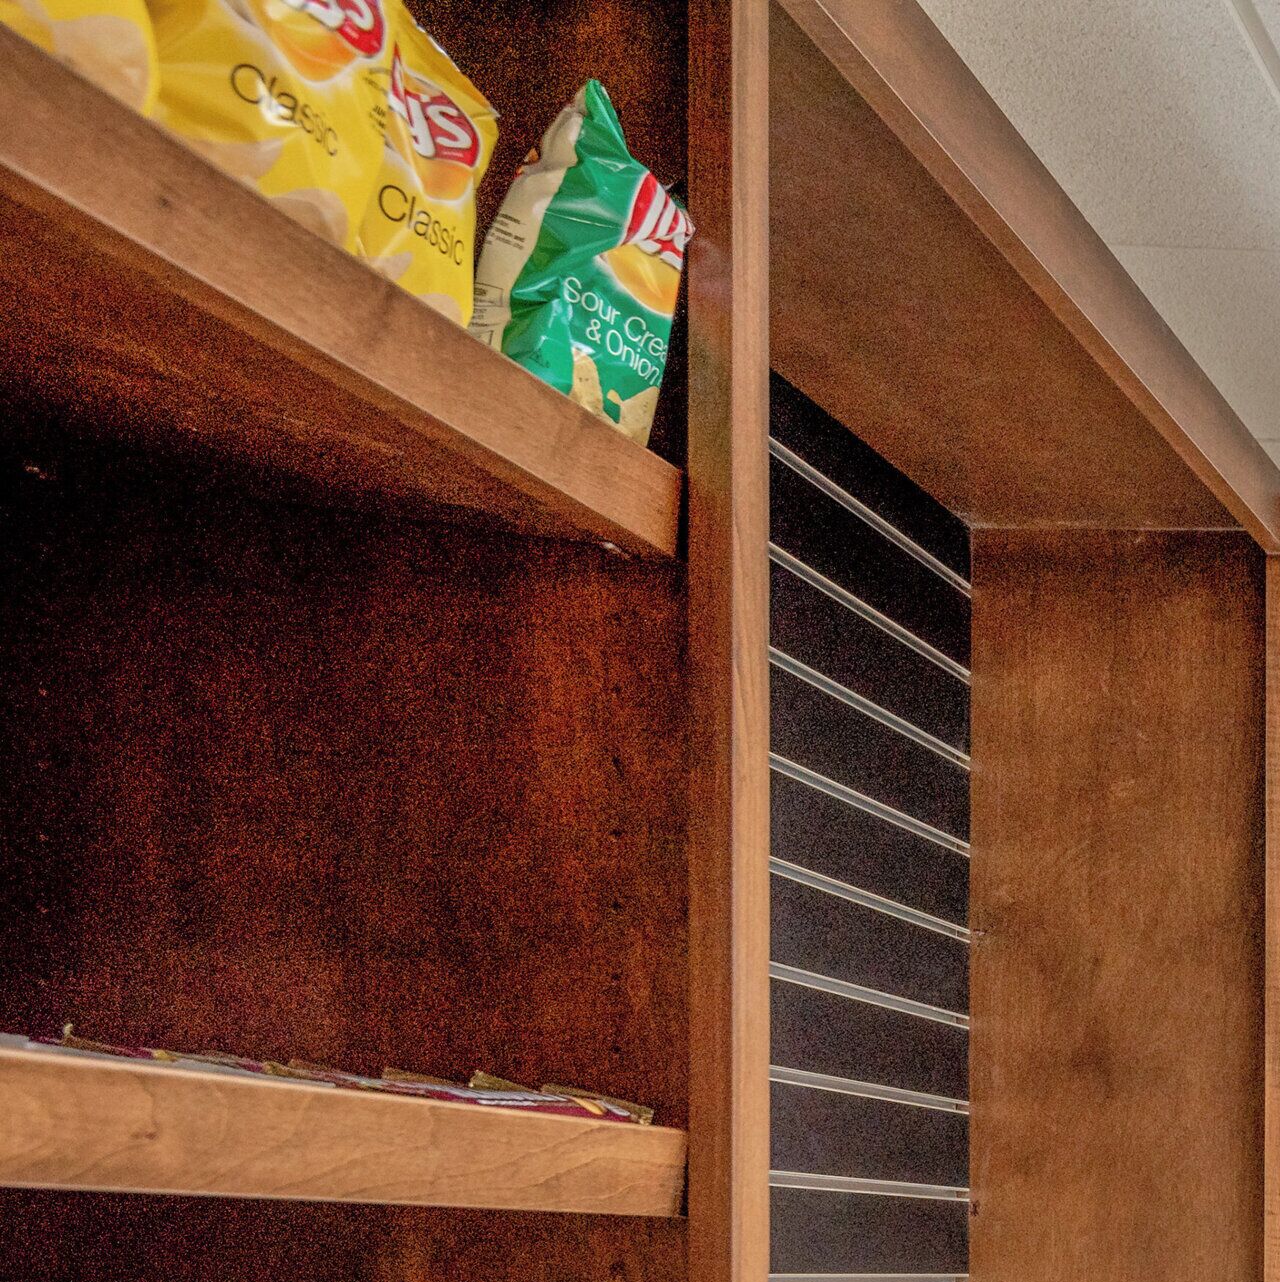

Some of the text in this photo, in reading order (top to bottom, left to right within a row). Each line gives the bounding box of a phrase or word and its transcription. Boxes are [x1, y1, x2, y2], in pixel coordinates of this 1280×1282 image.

[231, 63, 338, 157] Classic
[378, 184, 465, 267] Classic
[563, 276, 669, 363] Sour Crea
[585, 318, 660, 386] & Onion
